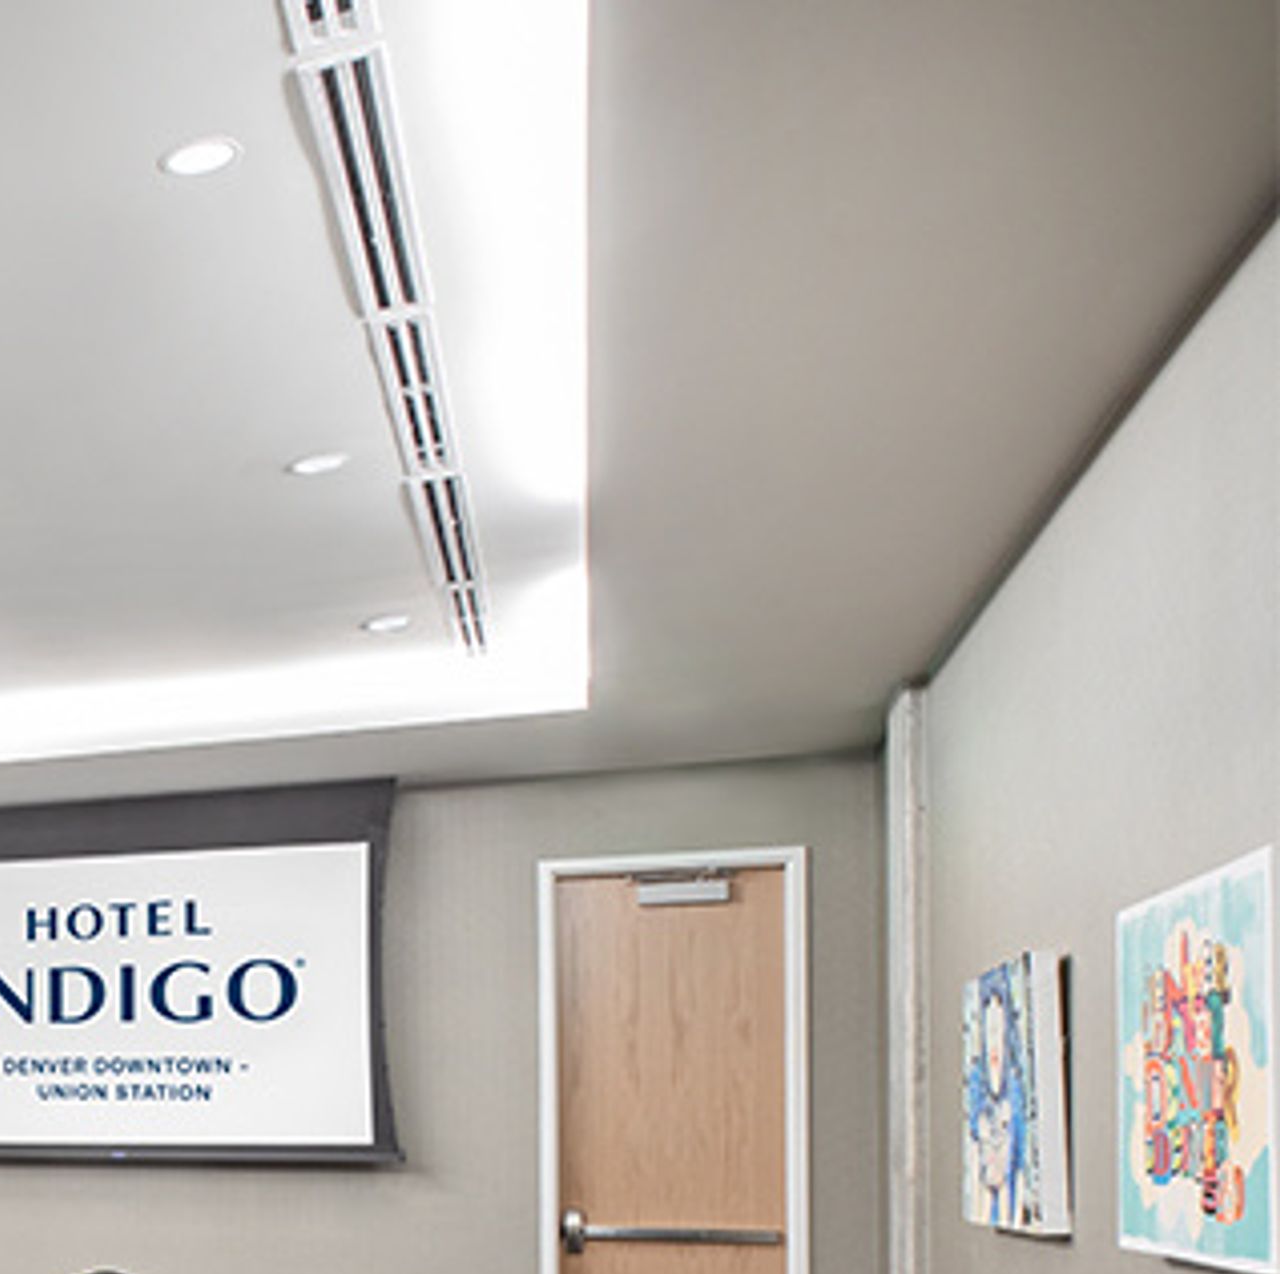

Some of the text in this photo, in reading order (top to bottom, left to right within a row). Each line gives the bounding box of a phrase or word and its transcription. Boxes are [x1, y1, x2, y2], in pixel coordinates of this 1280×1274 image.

[26, 900, 211, 942] HOTEL
[2, 1056, 88, 1075] DENVER
[93, 1056, 232, 1075] DOWNTOWN
[36, 1083, 212, 1101] UNION STATION
